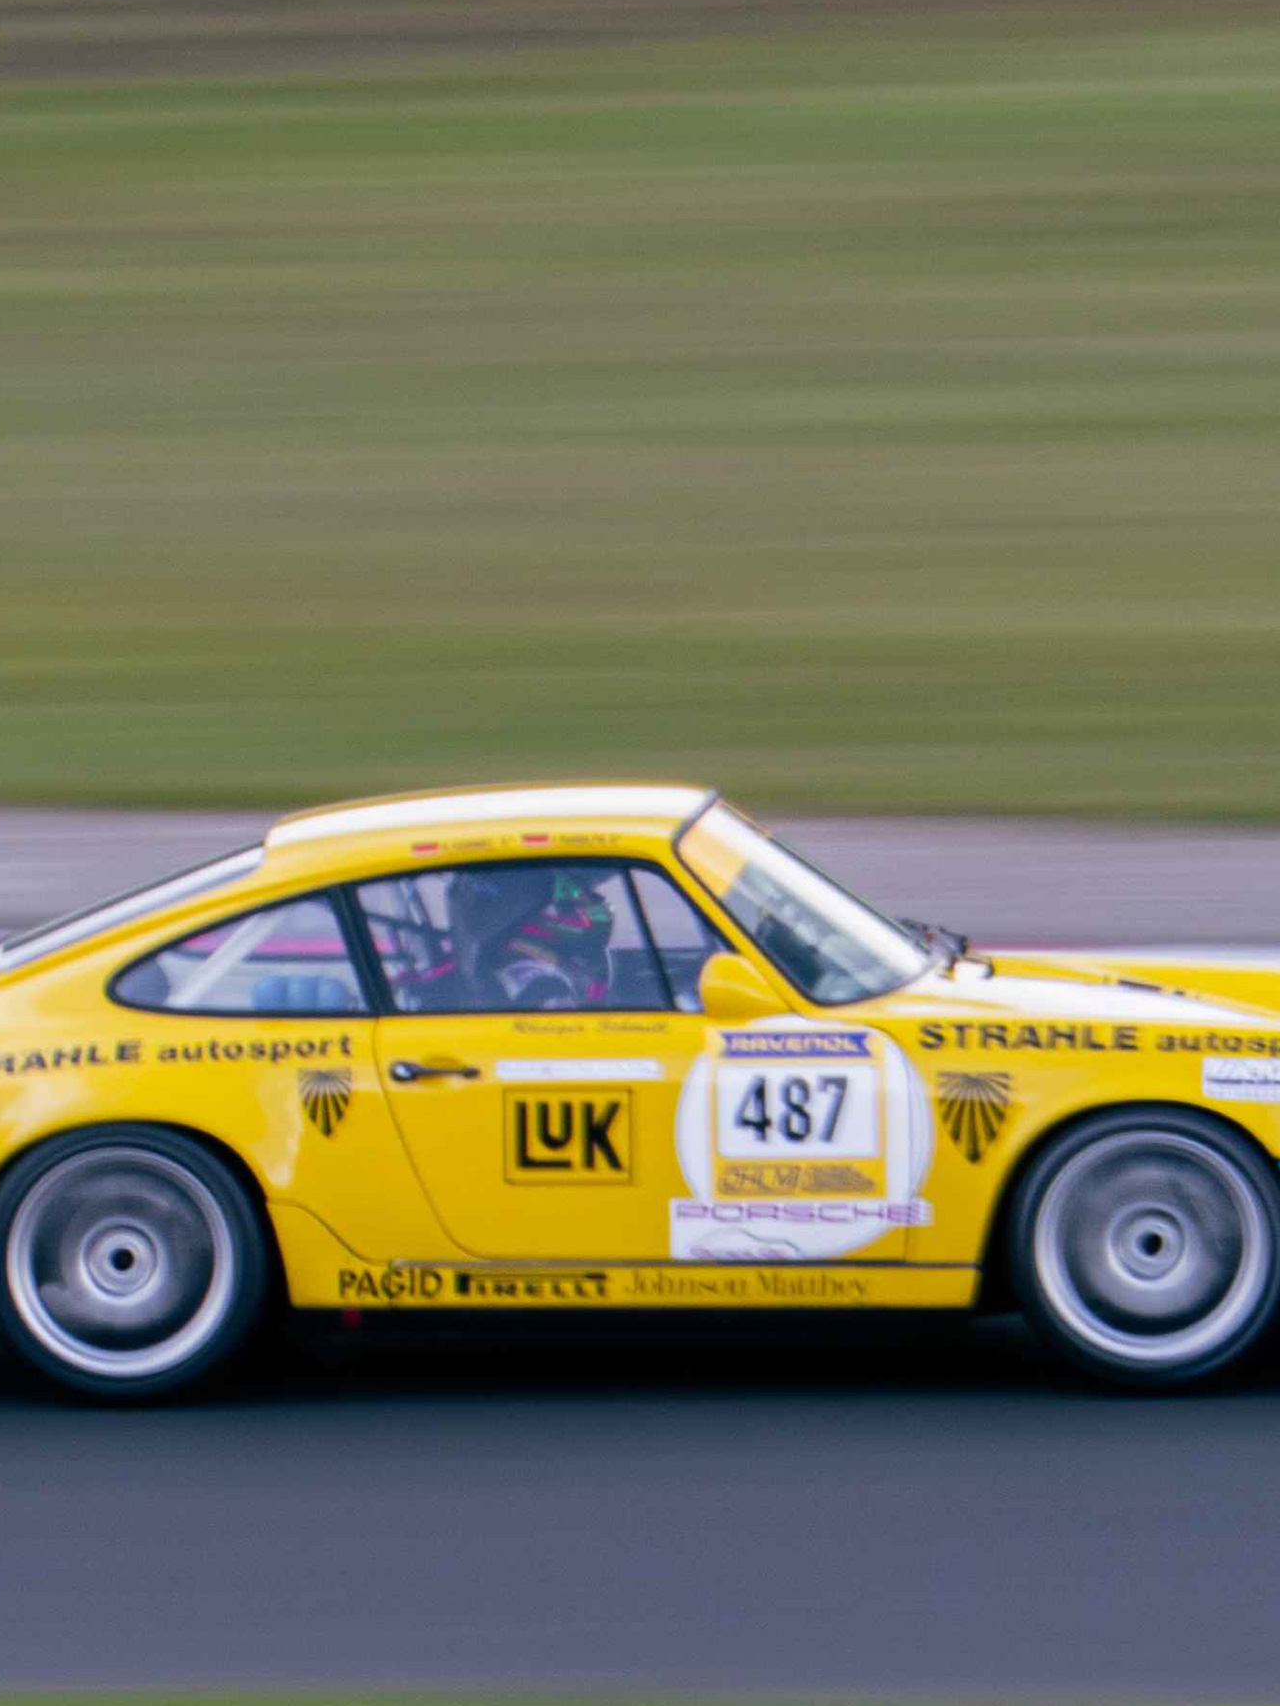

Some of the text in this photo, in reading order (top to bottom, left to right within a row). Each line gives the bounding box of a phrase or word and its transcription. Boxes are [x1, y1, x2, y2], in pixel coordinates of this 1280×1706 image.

[158, 1034, 351, 1064] autosport
[733, 1075, 848, 1143] 487
[677, 1203, 919, 1224] PORSCHE
[338, 1269, 443, 1298] PAGID
[455, 1271, 607, 1297] PIRELLI
[625, 1268, 748, 1296] Johnson
